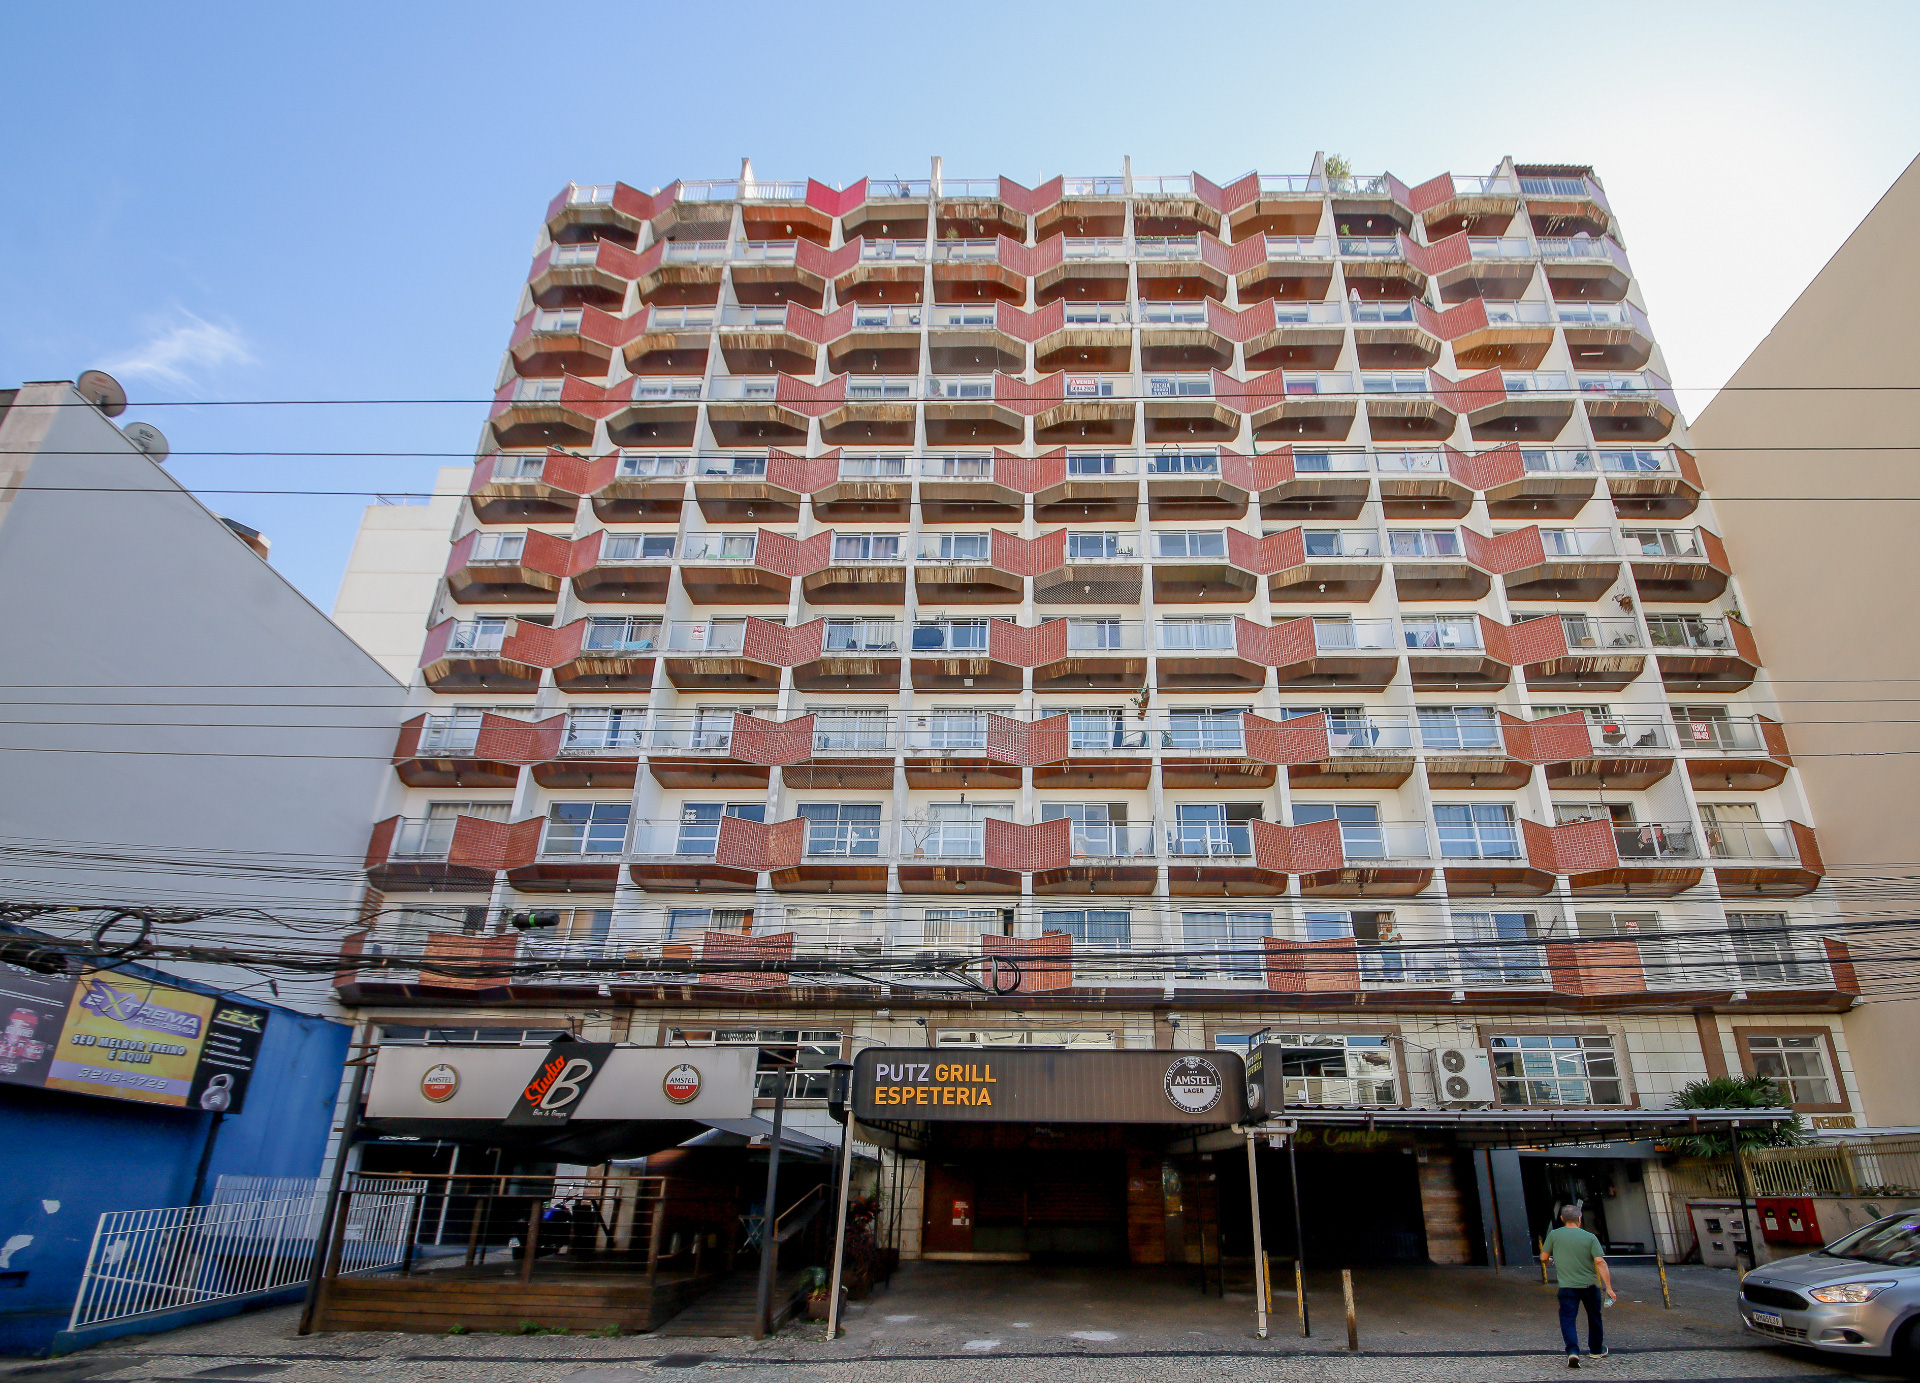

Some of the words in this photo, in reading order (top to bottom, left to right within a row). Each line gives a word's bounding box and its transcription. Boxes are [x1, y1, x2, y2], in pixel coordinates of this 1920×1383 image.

[84, 985, 199, 1028] EXTREMA
[135, 1017, 196, 1035] ACADEMIA
[71, 1034, 96, 1047] SEU
[96, 1037, 146, 1052] MELHOR
[147, 1042, 187, 1056] TREINO
[107, 1047, 118, 1061] É
[117, 1051, 153, 1064] AQUI!
[524, 1055, 566, 1107] Studio
[875, 1063, 930, 1082] PUTZ
[935, 1064, 997, 1083] GRILL
[1174, 1076, 1212, 1085] AMSTEL
[540, 1058, 593, 1110] B
[874, 1086, 992, 1106] ESPETERIA
[1811, 1116, 1857, 1129] RENOIR
[1323, 1128, 1388, 1149] Campo
